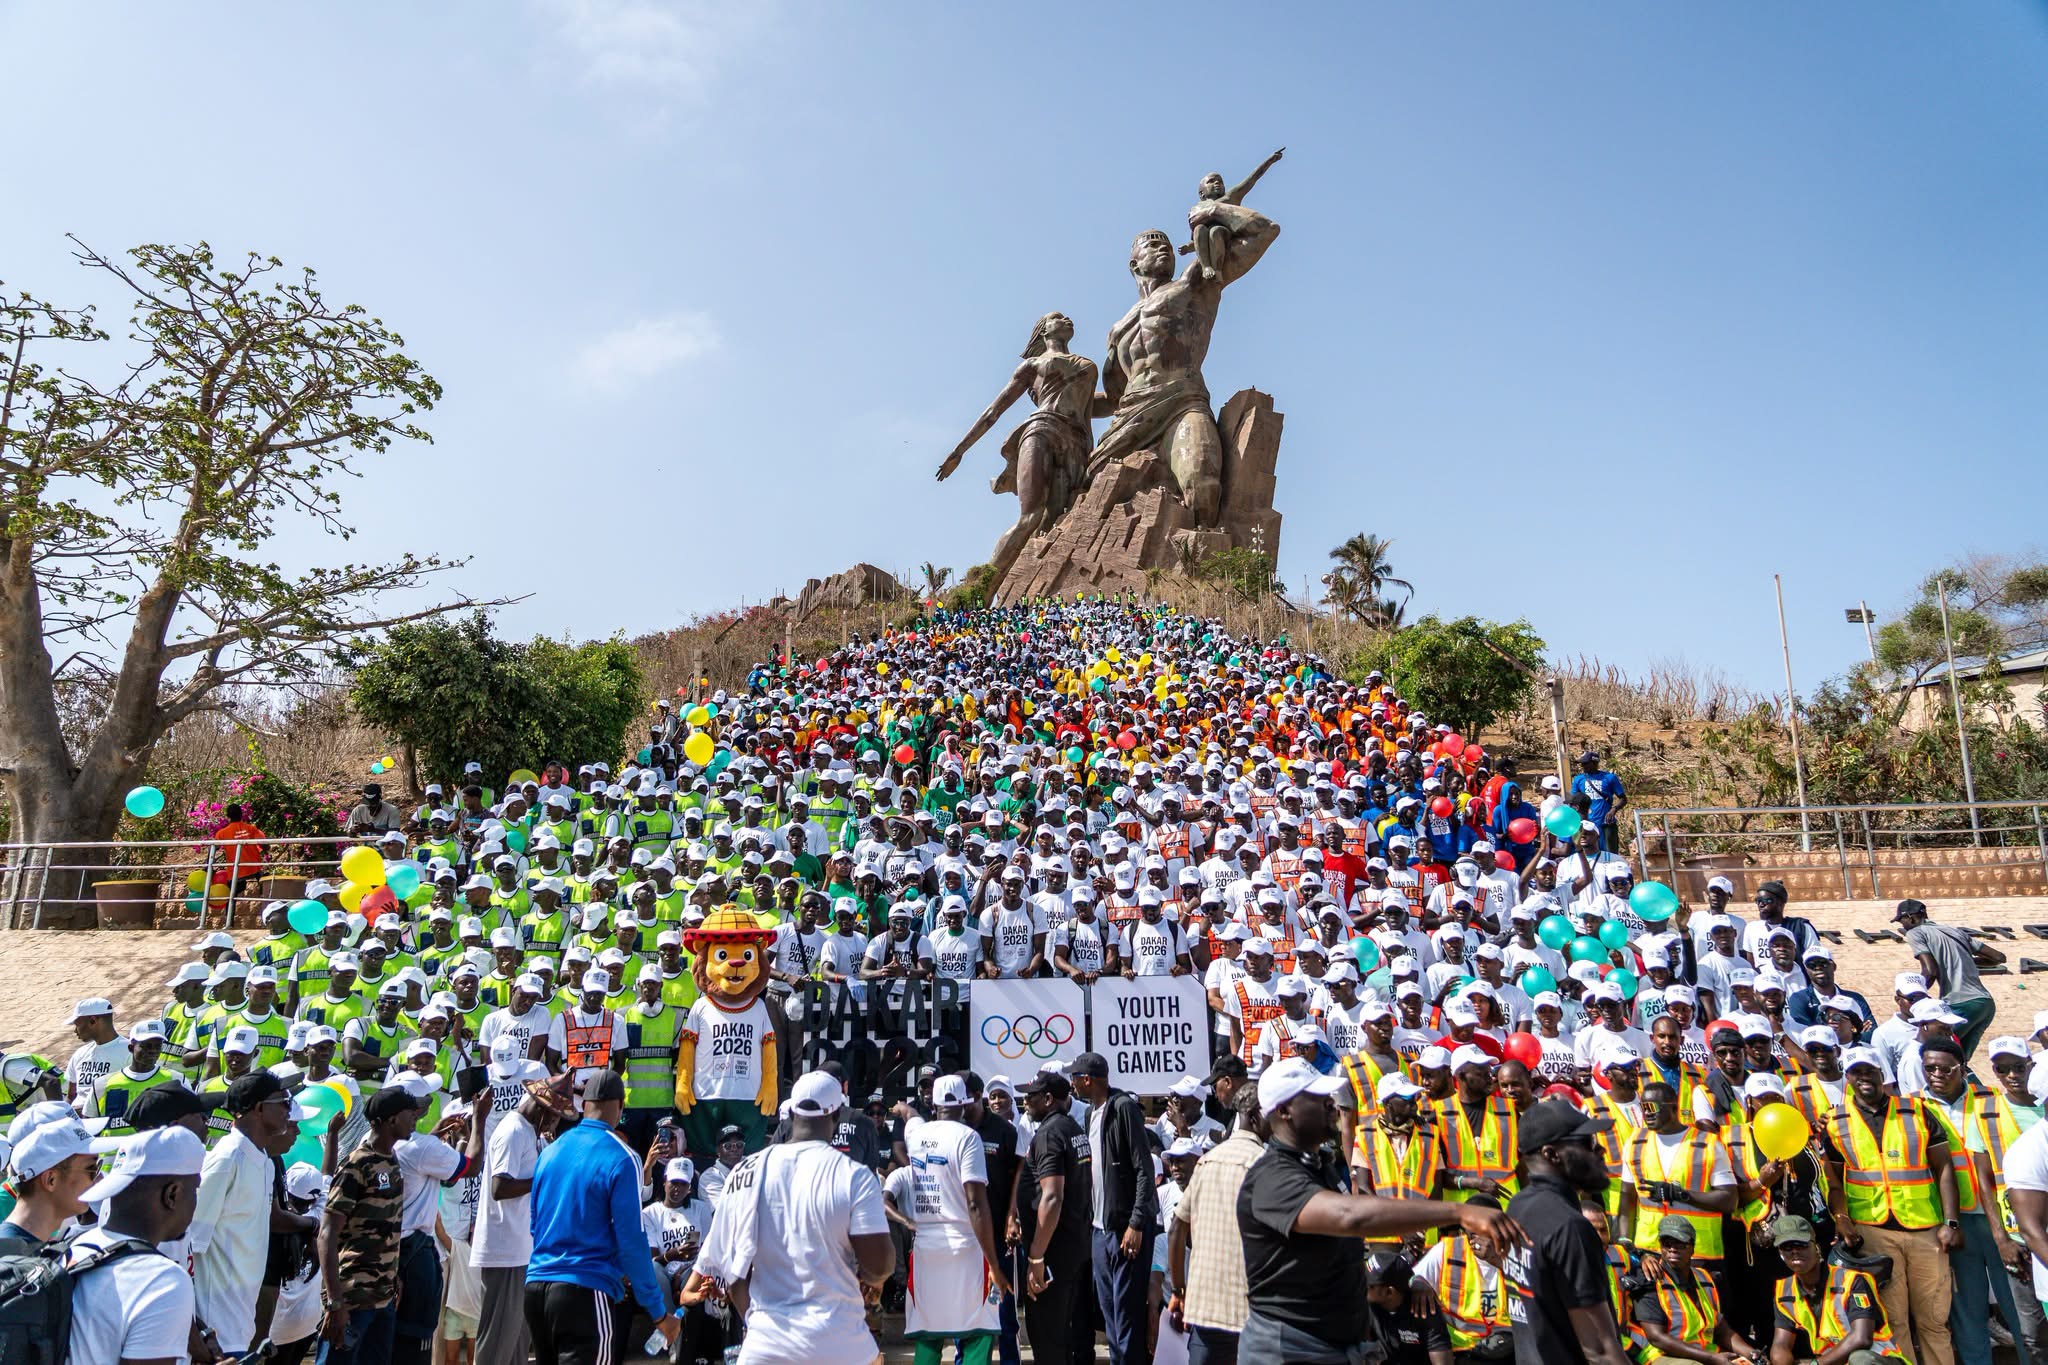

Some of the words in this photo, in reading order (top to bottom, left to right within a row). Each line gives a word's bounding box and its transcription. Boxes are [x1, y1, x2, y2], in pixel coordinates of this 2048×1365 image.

[1215, 871, 1239, 879] DAKAR
[1424, 872, 1438, 880] KAR
[1487, 884, 1502, 894] KAR
[1002, 925, 1028, 935] DAKAR
[1003, 935, 1028, 946] 2026
[1141, 936, 1168, 946] DAKAR
[1141, 946, 1167, 956] 2026
[941, 952, 967, 962] DAKAR
[941, 962, 967, 972] 2026
[1117, 995, 1181, 1019] YOUTH
[713, 1022, 754, 1039] DAKAR
[1107, 1022, 1193, 1046] OLYMPIC
[1334, 1025, 1358, 1036] DAKAR
[712, 1037, 752, 1056] 2026
[1335, 1036, 1357, 1048] 2026
[1117, 1050, 1186, 1074] GAMES
[1542, 1052, 1575, 1063] DAKAR
[81, 1061, 111, 1073] DAKAR
[1544, 1062, 1574, 1075] 2026
[493, 1097, 521, 1112] 202
